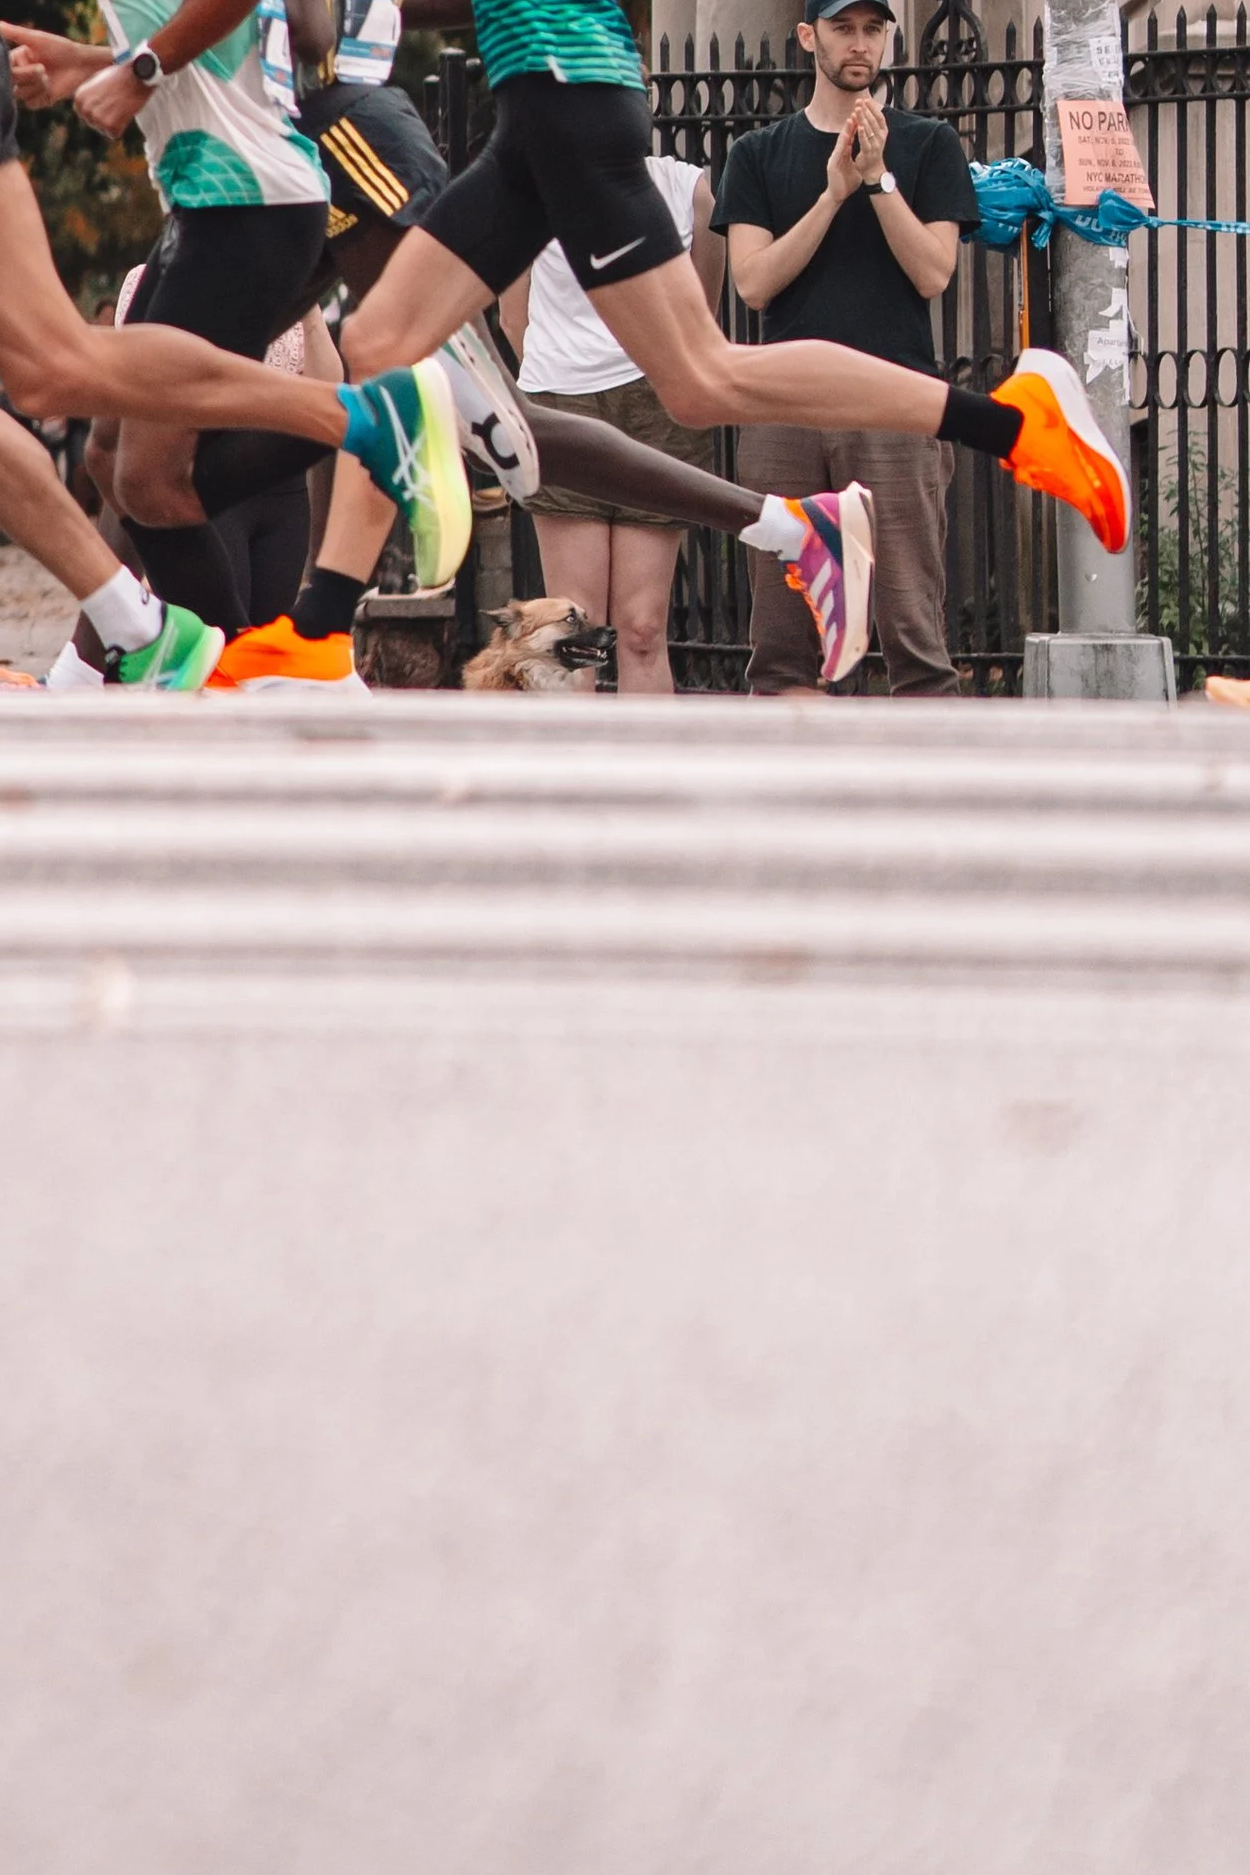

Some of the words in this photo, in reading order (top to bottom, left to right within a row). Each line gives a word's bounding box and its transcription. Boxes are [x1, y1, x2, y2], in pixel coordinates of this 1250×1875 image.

[1069, 111, 1093, 130] NO
[1115, 148, 1124, 156] TO
[1086, 171, 1103, 183] NYC
[1104, 171, 1146, 185] MARATHO
